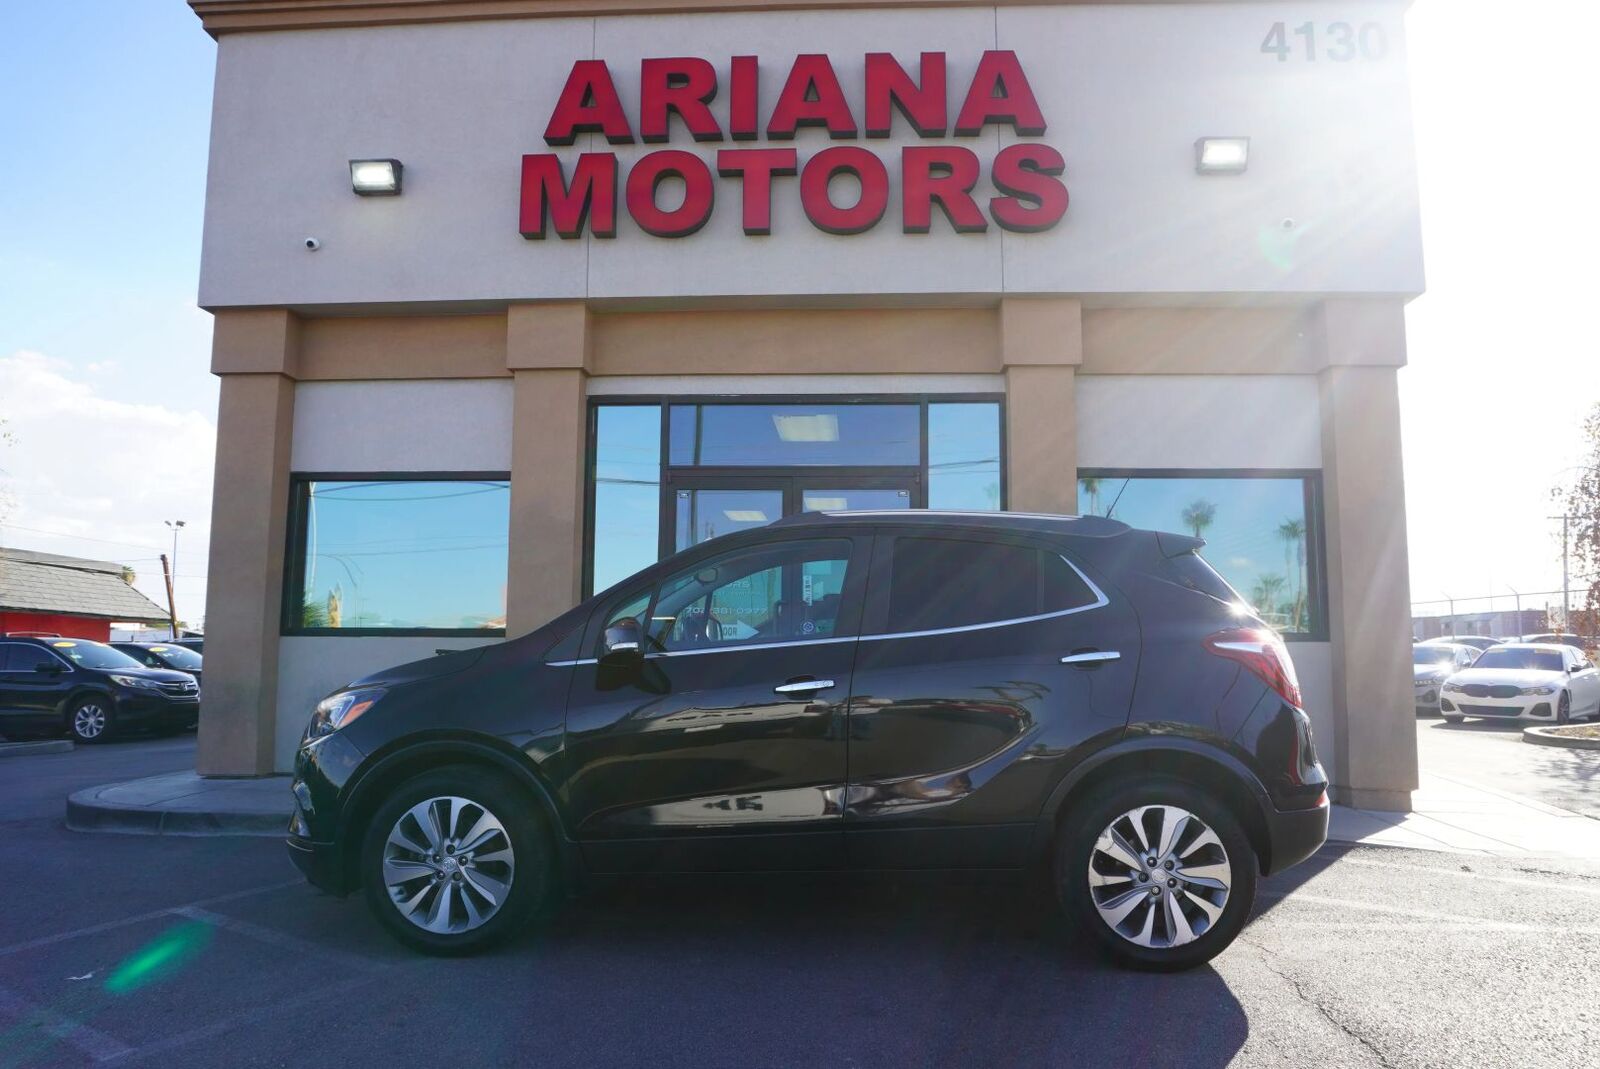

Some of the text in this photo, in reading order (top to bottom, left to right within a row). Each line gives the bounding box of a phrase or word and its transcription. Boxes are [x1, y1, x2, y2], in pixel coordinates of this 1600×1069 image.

[1260, 21, 1389, 62] 4130
[543, 50, 1047, 146] ARIANA
[519, 143, 1070, 239] MOTORS
